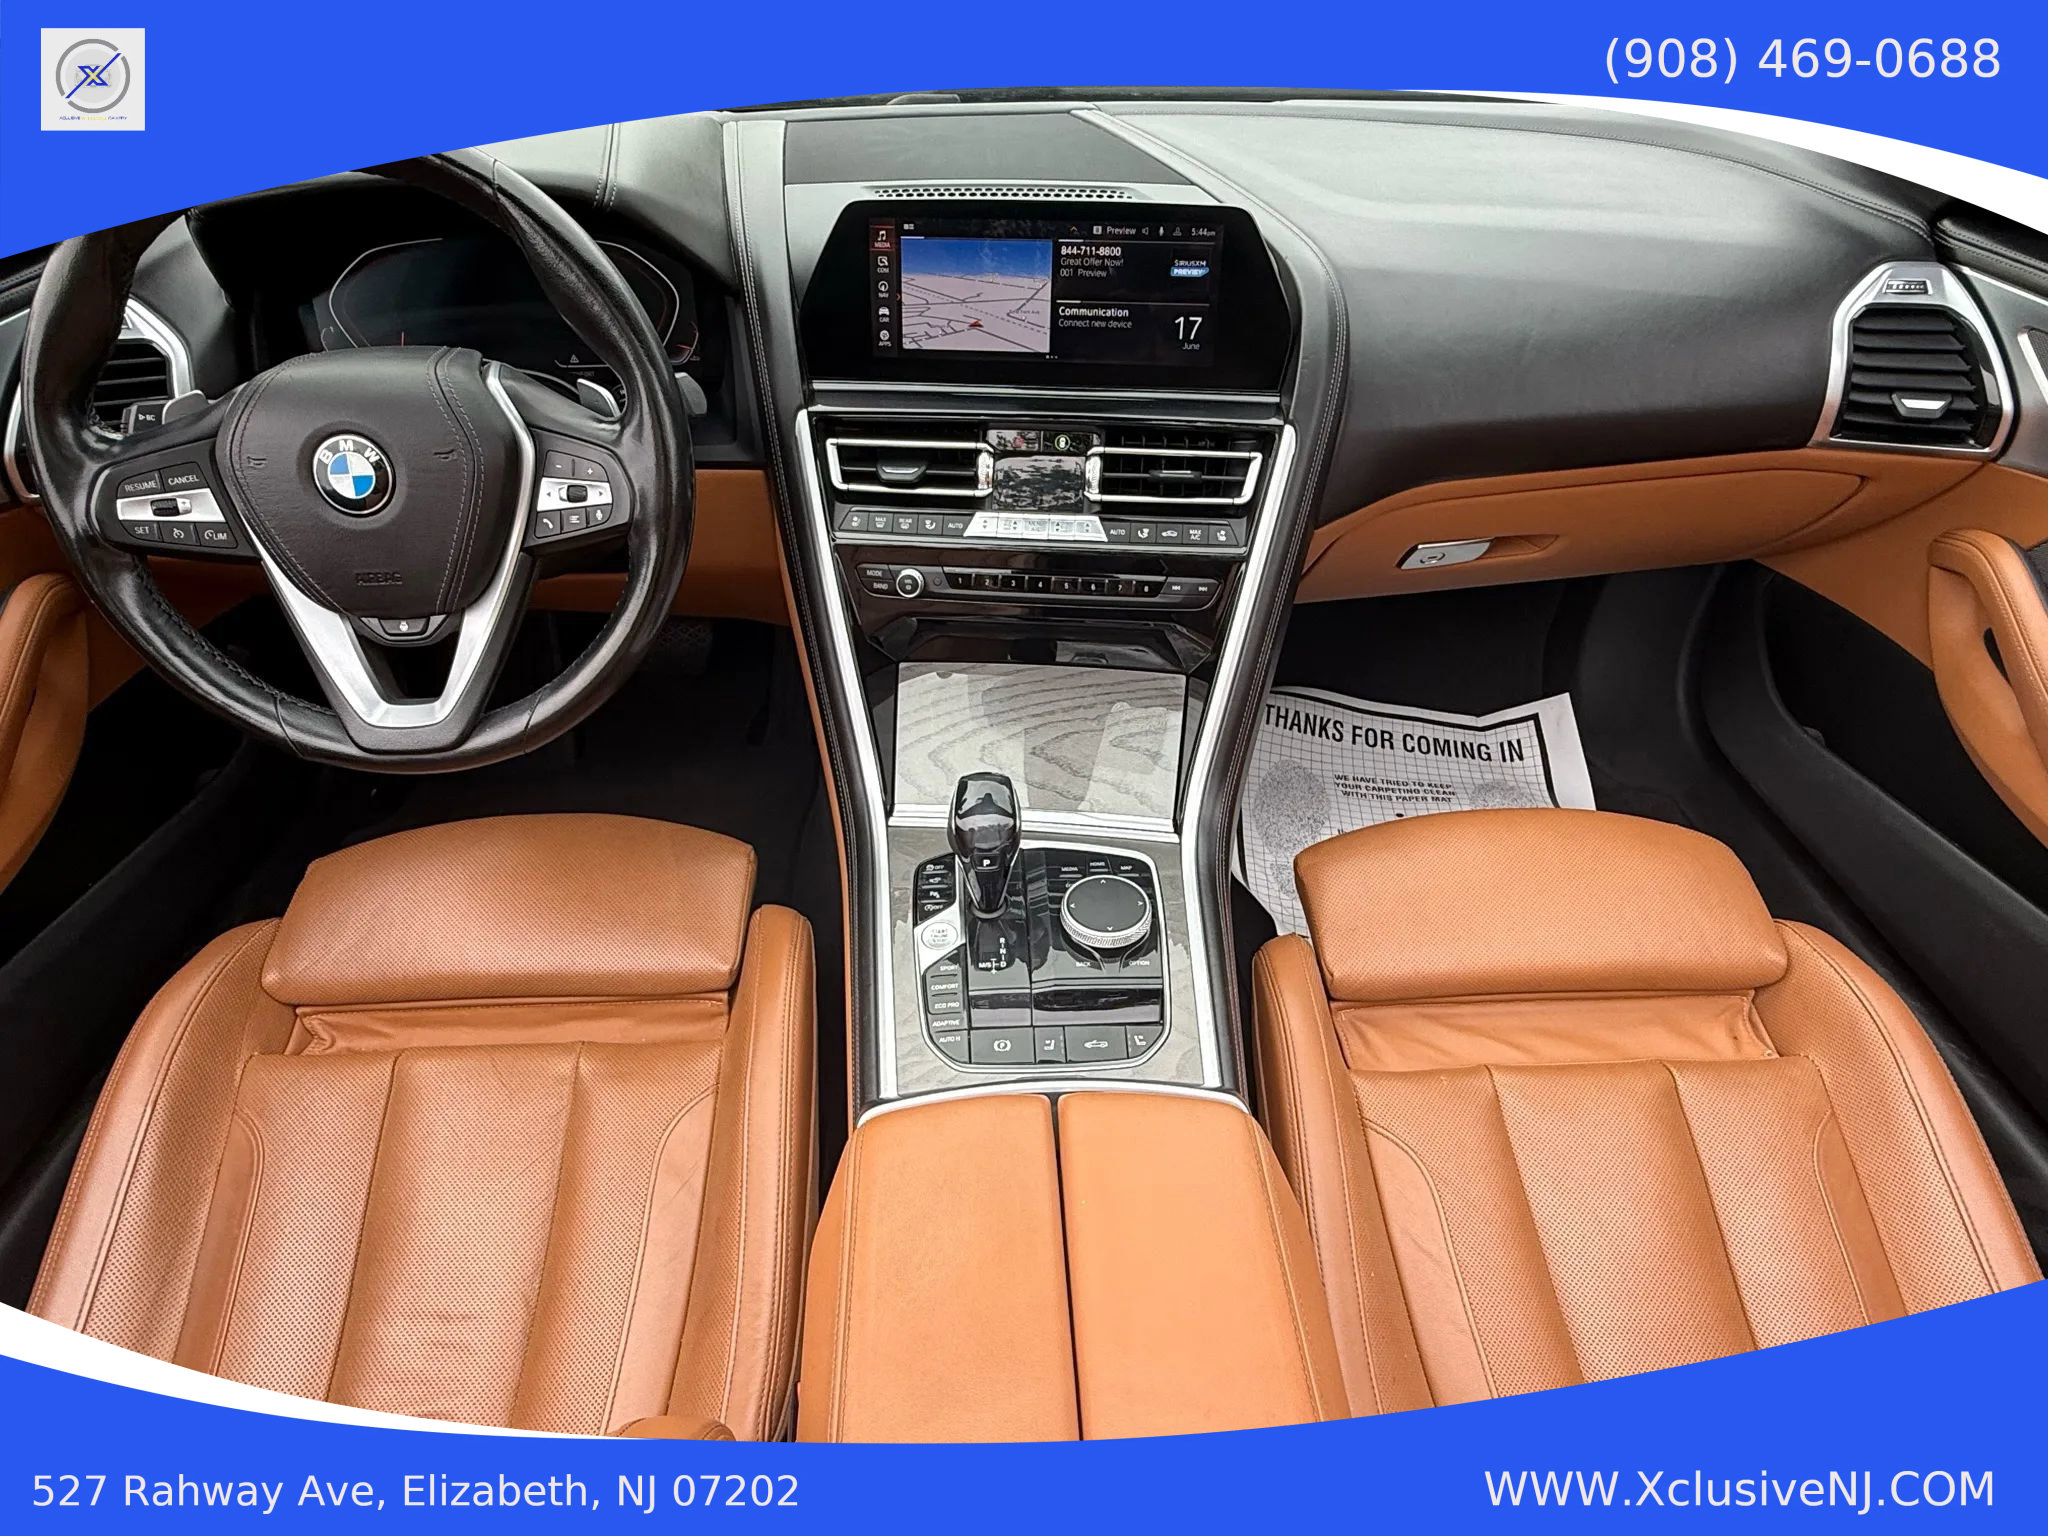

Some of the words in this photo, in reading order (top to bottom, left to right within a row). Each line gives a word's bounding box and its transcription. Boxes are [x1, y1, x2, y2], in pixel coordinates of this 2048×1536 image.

[1106, 225, 1136, 235] Preview
[1060, 245, 1122, 257] 844-711-8800
[1060, 257, 1082, 266] Great
[1084, 257, 1103, 266] Offer
[1104, 258, 1124, 267] Now!
[1060, 268, 1074, 277] 001
[1077, 268, 1107, 277] Preview
[1058, 306, 1129, 317] Communication
[1058, 318, 1090, 328] Connect
[1091, 320, 1107, 328] new
[1108, 319, 1132, 329] device
[1174, 316, 1203, 341] 17
[1182, 342, 1200, 351] June
[319, 439, 380, 465] BMW
[168, 474, 200, 486] CANCEL
[124, 480, 158, 493] RESUME
[134, 526, 150, 535] SET
[213, 532, 227, 541] LIM
[1265, 704, 1344, 743] THANKS
[1351, 725, 1394, 750] FOR
[1402, 733, 1492, 762] COMING
[1499, 738, 1524, 763] IN
[1352, 775, 1377, 785] HAVE
[1380, 778, 1409, 787] TRIED
[1334, 782, 1362, 791] YOUR
[1365, 783, 1420, 795] CARPETING
[1423, 788, 1456, 797] CLEAN
[1341, 790, 1367, 799] WITH
[1371, 793, 1393, 801] THIS
[983, 859, 991, 867] P
[932, 1019, 960, 1027] ADAPTIVE
